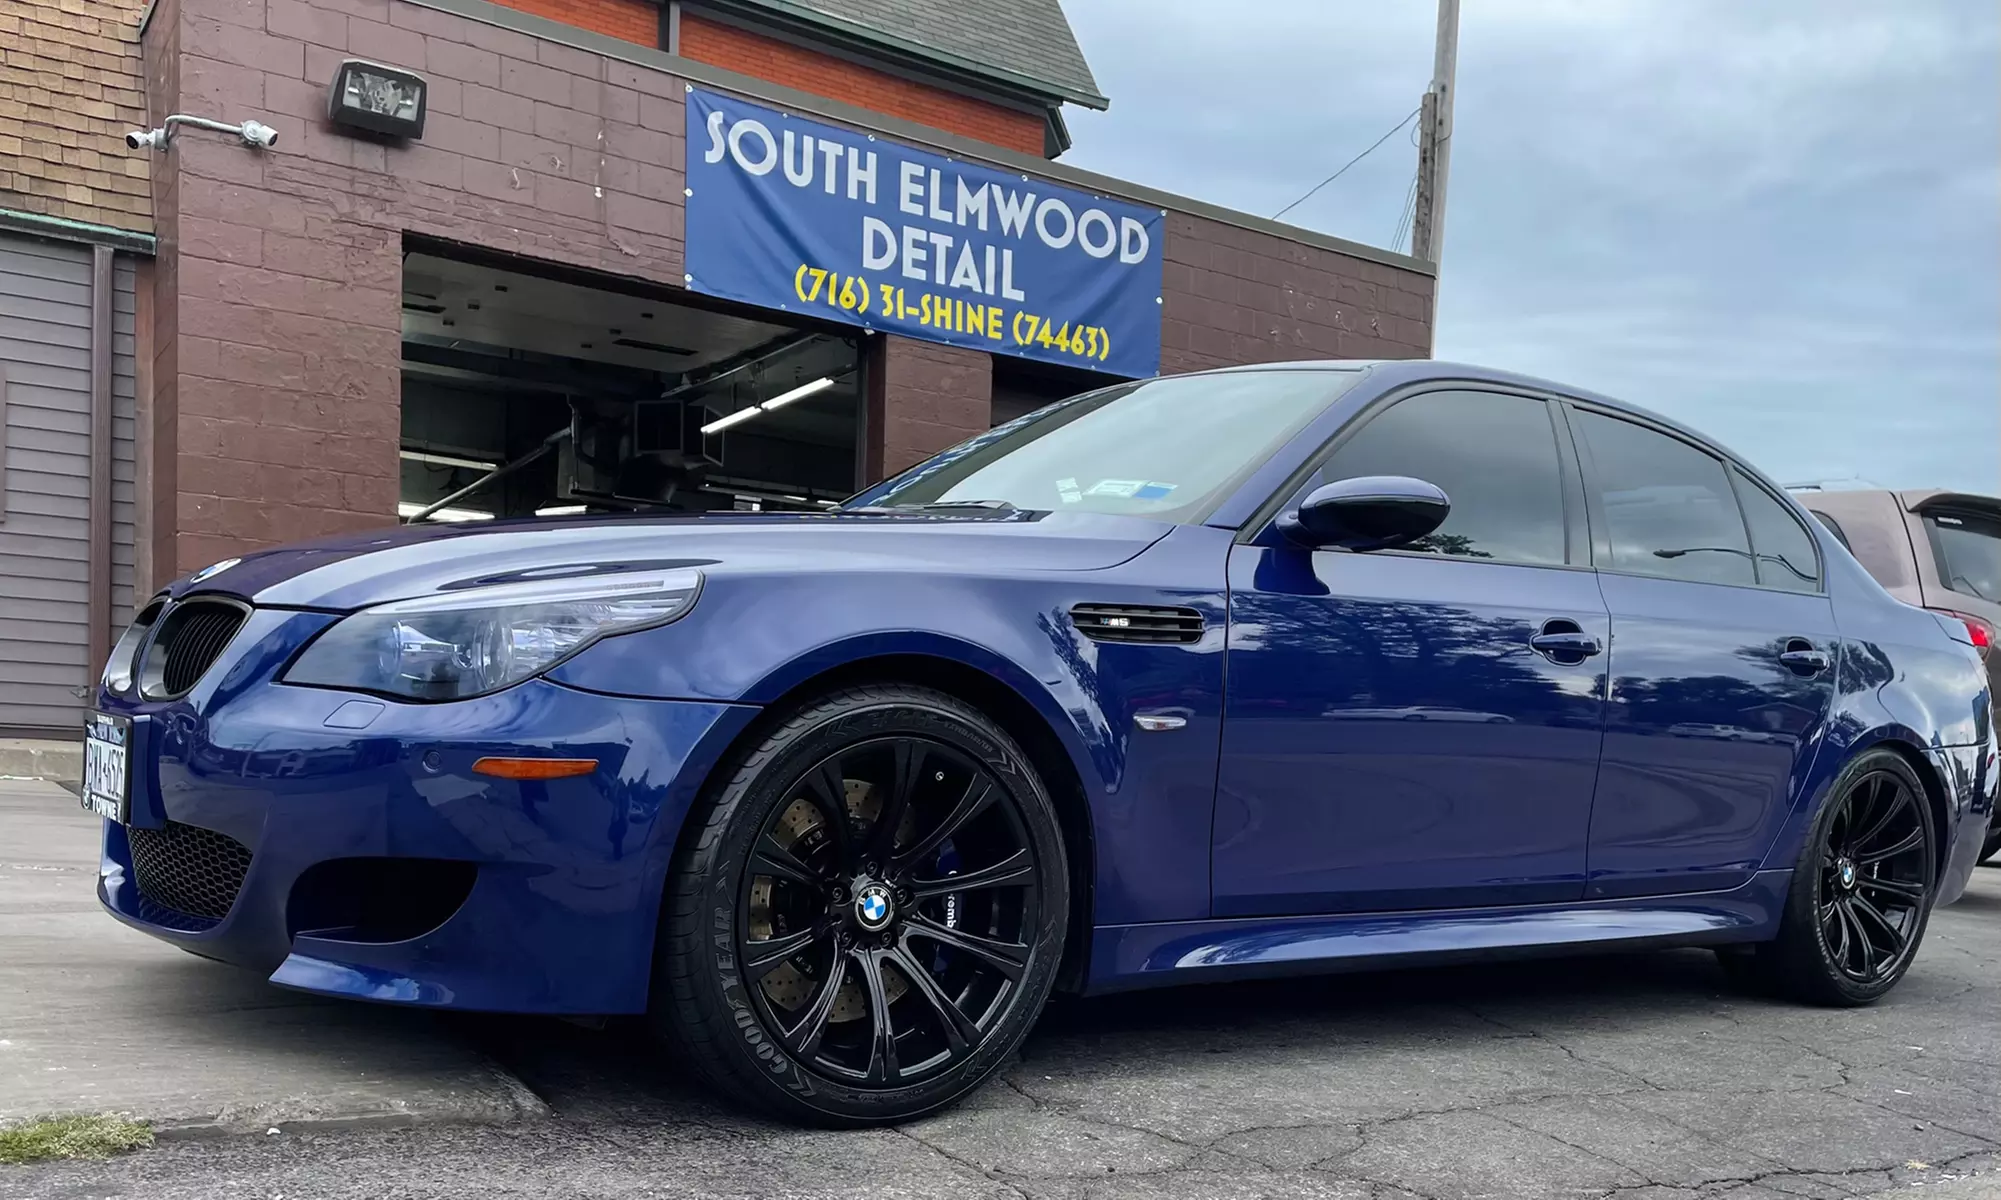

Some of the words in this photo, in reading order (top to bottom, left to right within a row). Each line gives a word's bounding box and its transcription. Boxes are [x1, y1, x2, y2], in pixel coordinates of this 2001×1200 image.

[705, 111, 877, 204] SOUTH
[900, 161, 1149, 264] ELMWOOD
[863, 216, 1025, 302] DETAIL
[795, 264, 870, 313] (716)
[880, 284, 1003, 339] 31-SHINE
[1013, 311, 1109, 361] (74463)
